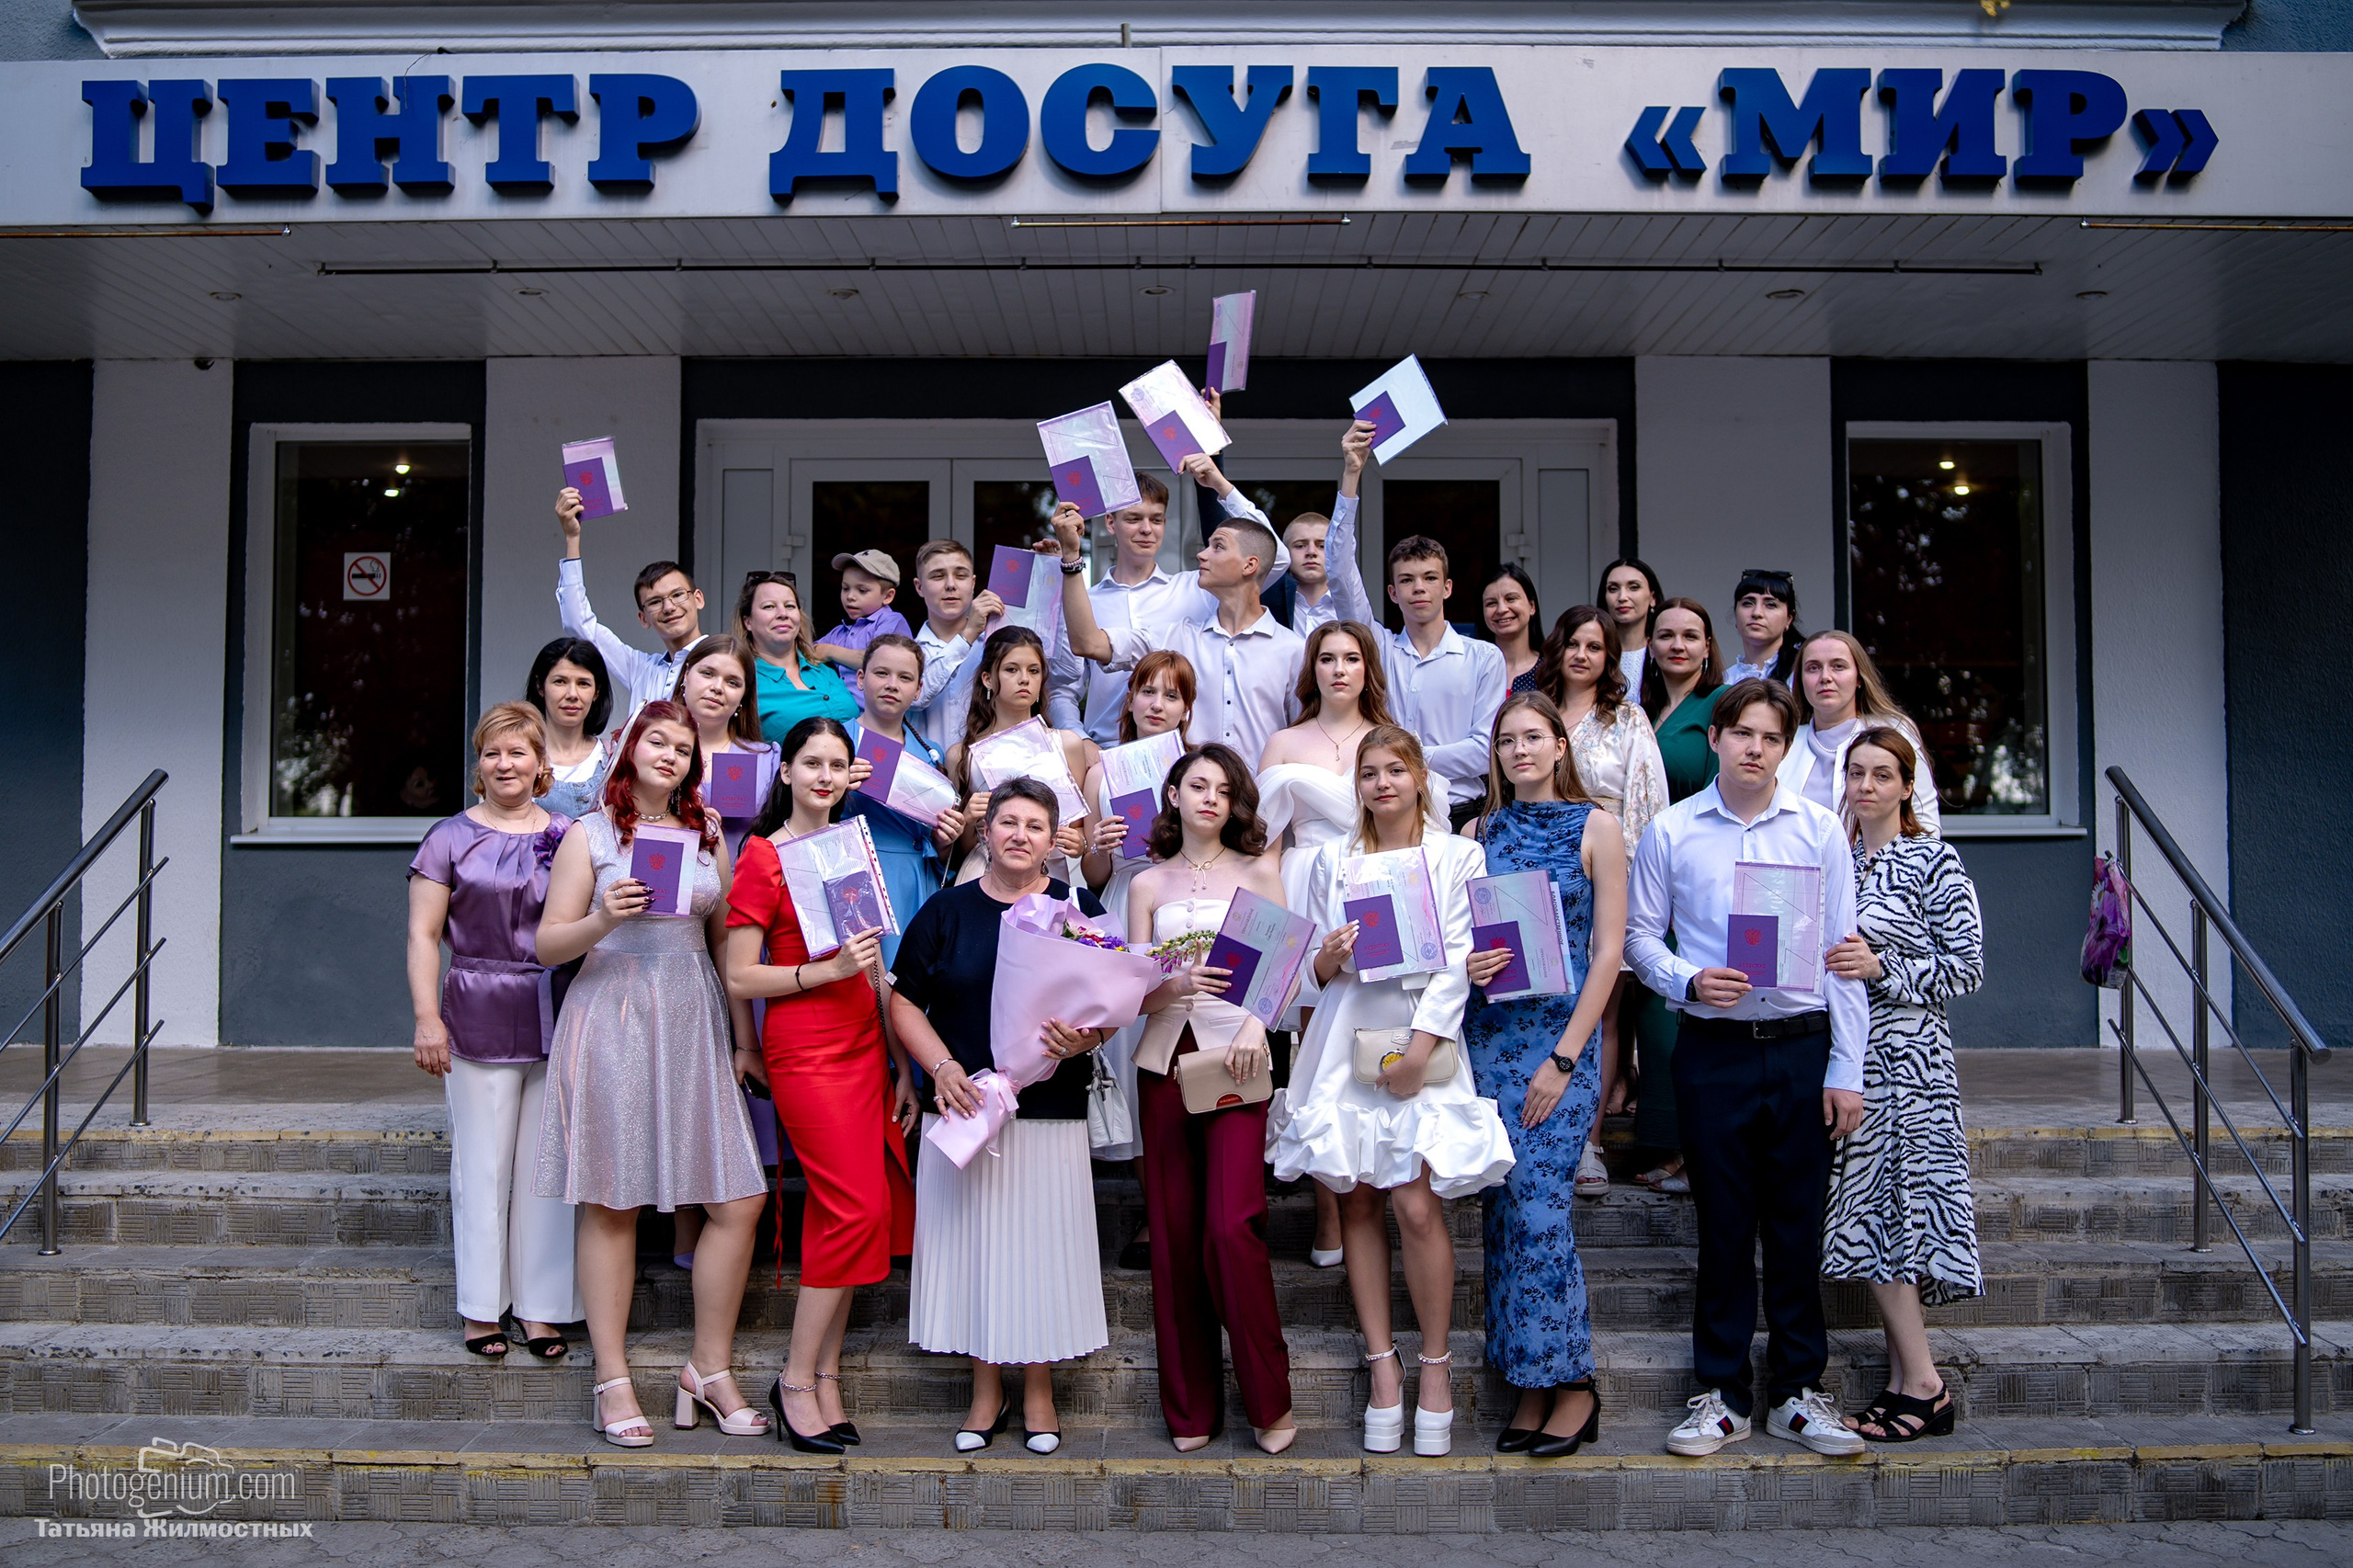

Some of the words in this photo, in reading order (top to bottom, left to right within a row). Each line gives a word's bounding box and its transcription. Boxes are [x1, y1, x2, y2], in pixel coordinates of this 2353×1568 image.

[81, 74, 702, 211] ЦЕНТР
[769, 62, 1532, 200] ДОСУГА
[1624, 67, 2220, 185] «МИР»
